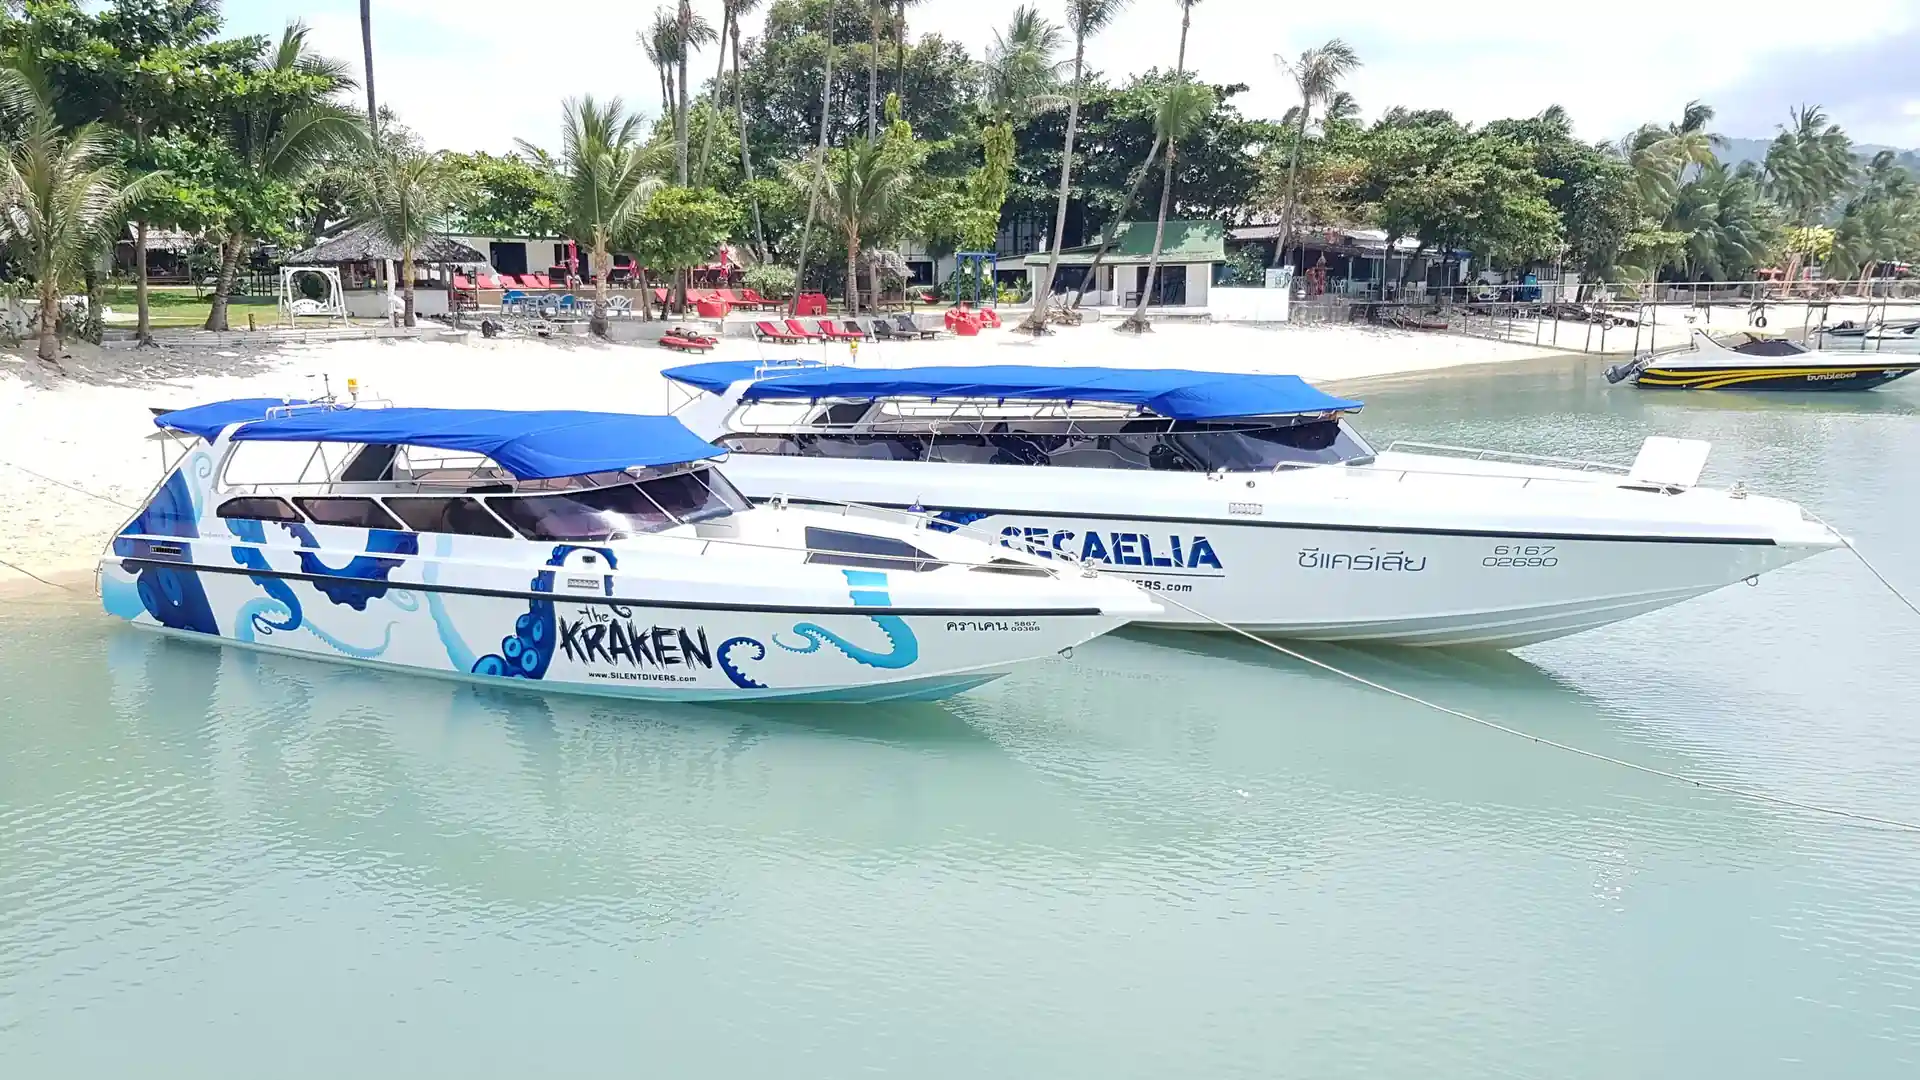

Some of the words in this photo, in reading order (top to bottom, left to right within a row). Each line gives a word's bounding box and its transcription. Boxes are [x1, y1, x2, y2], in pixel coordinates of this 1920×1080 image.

[1000, 526, 1224, 568] CECAELIA
[1494, 545, 1556, 555] 6167
[1482, 557, 1559, 567] 02690
[946, 621, 1009, 632] คราเคน
[558, 615, 713, 671] KRAKEN
[588, 671, 698, 683] www.SILENTDIVERS.com
